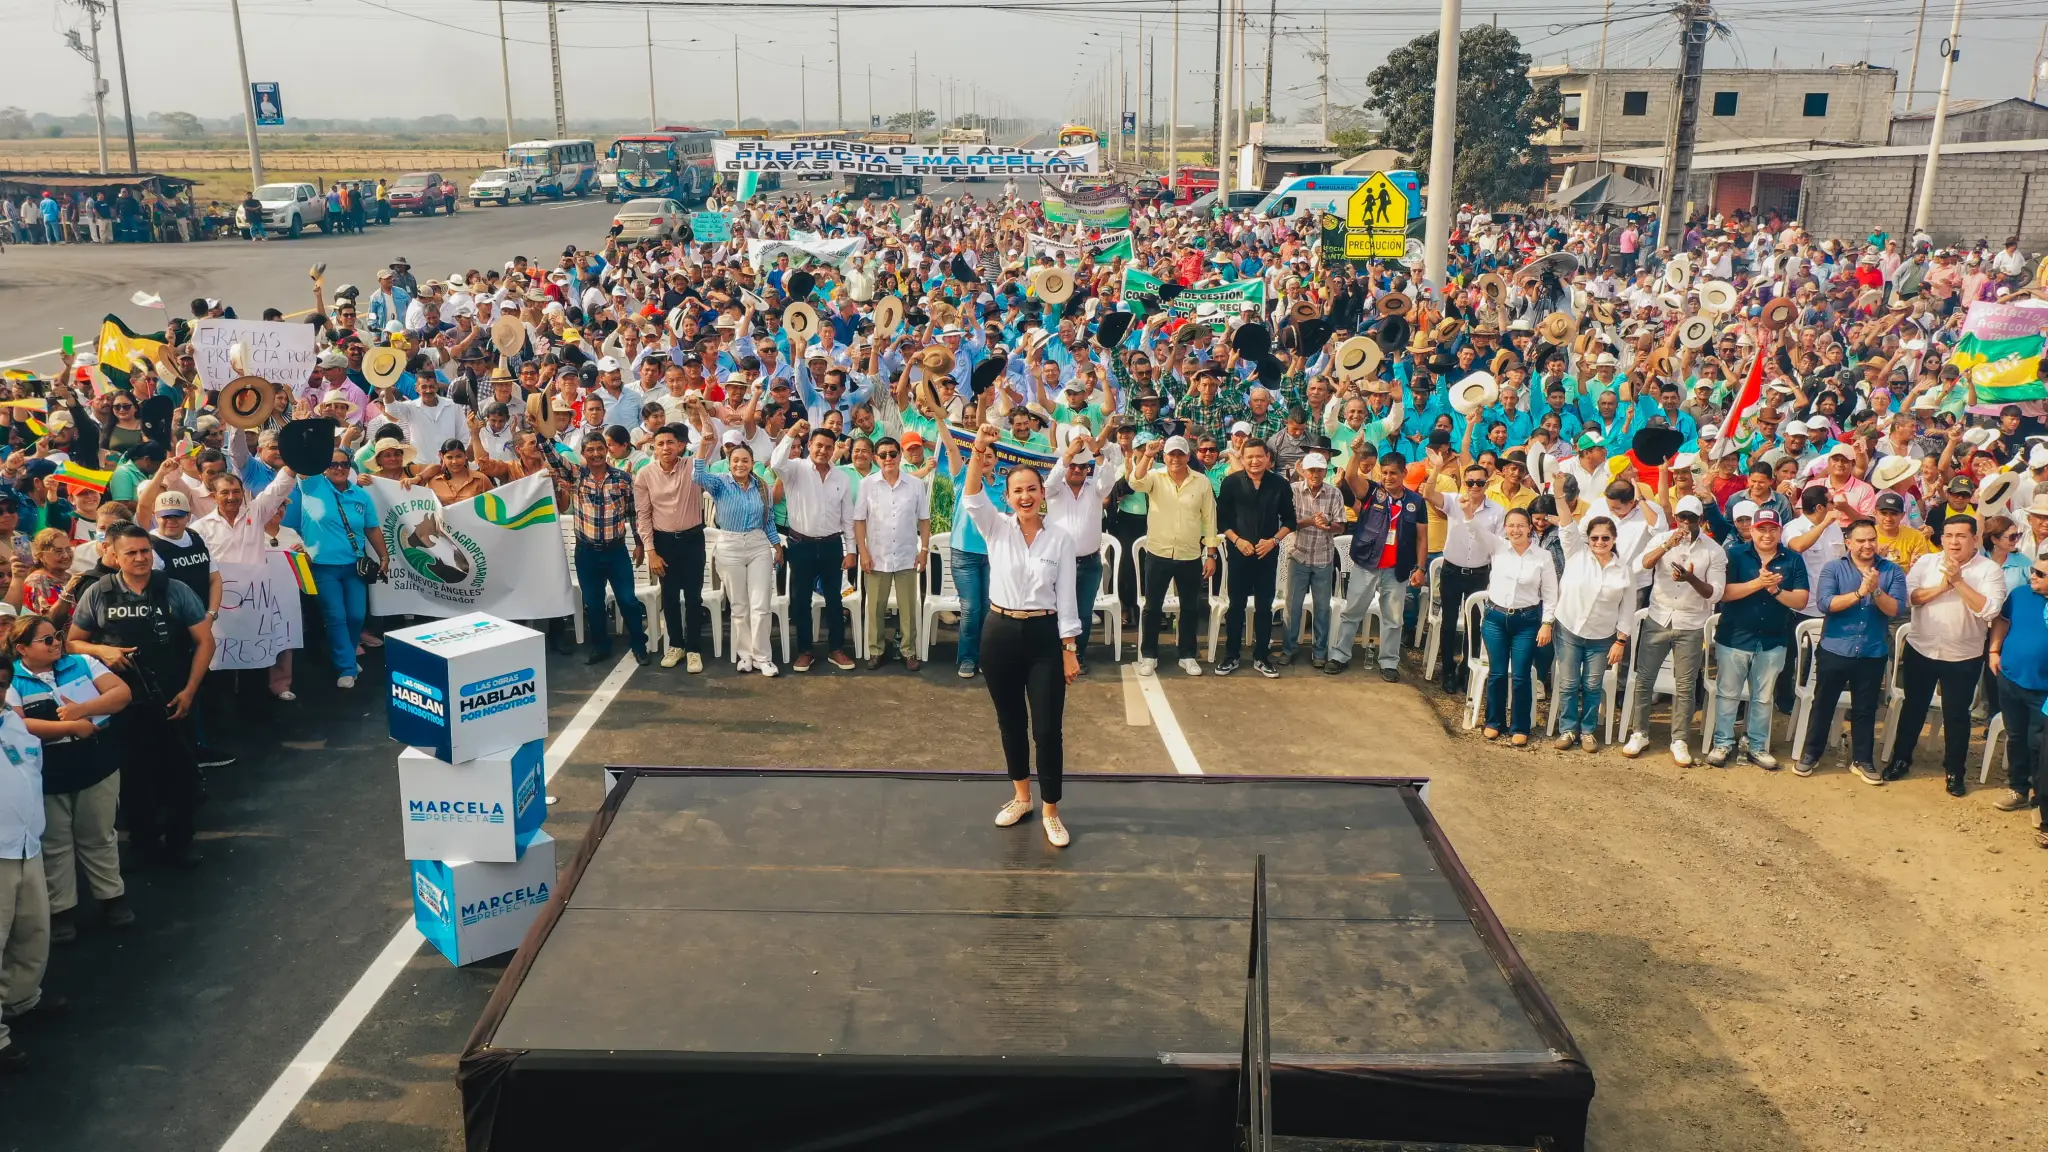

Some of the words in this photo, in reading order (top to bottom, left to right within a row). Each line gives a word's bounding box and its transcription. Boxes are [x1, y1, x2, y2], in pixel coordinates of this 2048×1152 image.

[739, 142, 775, 151] EL
[790, 141, 907, 155] PUEBLO
[923, 147, 959, 155] TE
[725, 160, 829, 170] GUAYAS
[839, 161, 903, 173] PIDE
[736, 150, 889, 164] PREFECTA
[923, 155, 1066, 165] MARCELA
[201, 327, 281, 348] GRACIAS
[286, 350, 311, 362] POR
[207, 366, 220, 379] EL
[396, 502, 409, 516] DE
[452, 531, 488, 588] AGROPECUARIOS
[172, 552, 209, 568] POLICIA
[407, 571, 438, 590] NUEVOS
[394, 581, 425, 593] Salitre
[434, 591, 475, 604] Ecuador
[402, 679, 413, 688] LAS
[413, 683, 432, 696] OBRAS
[475, 683, 491, 692] LAS
[494, 674, 519, 688] OBRAS
[391, 684, 444, 717] HABLAN
[460, 681, 535, 713] HABLAN
[393, 697, 408, 712] POR
[407, 703, 444, 727] NOSOTROS
[461, 709, 482, 723] POR
[483, 694, 537, 717] NOSOTROS
[409, 800, 504, 815] MARCELA
[426, 813, 490, 823] PREFECTA
[461, 882, 549, 918] MARCELA
[477, 898, 536, 922] PREFECTA
